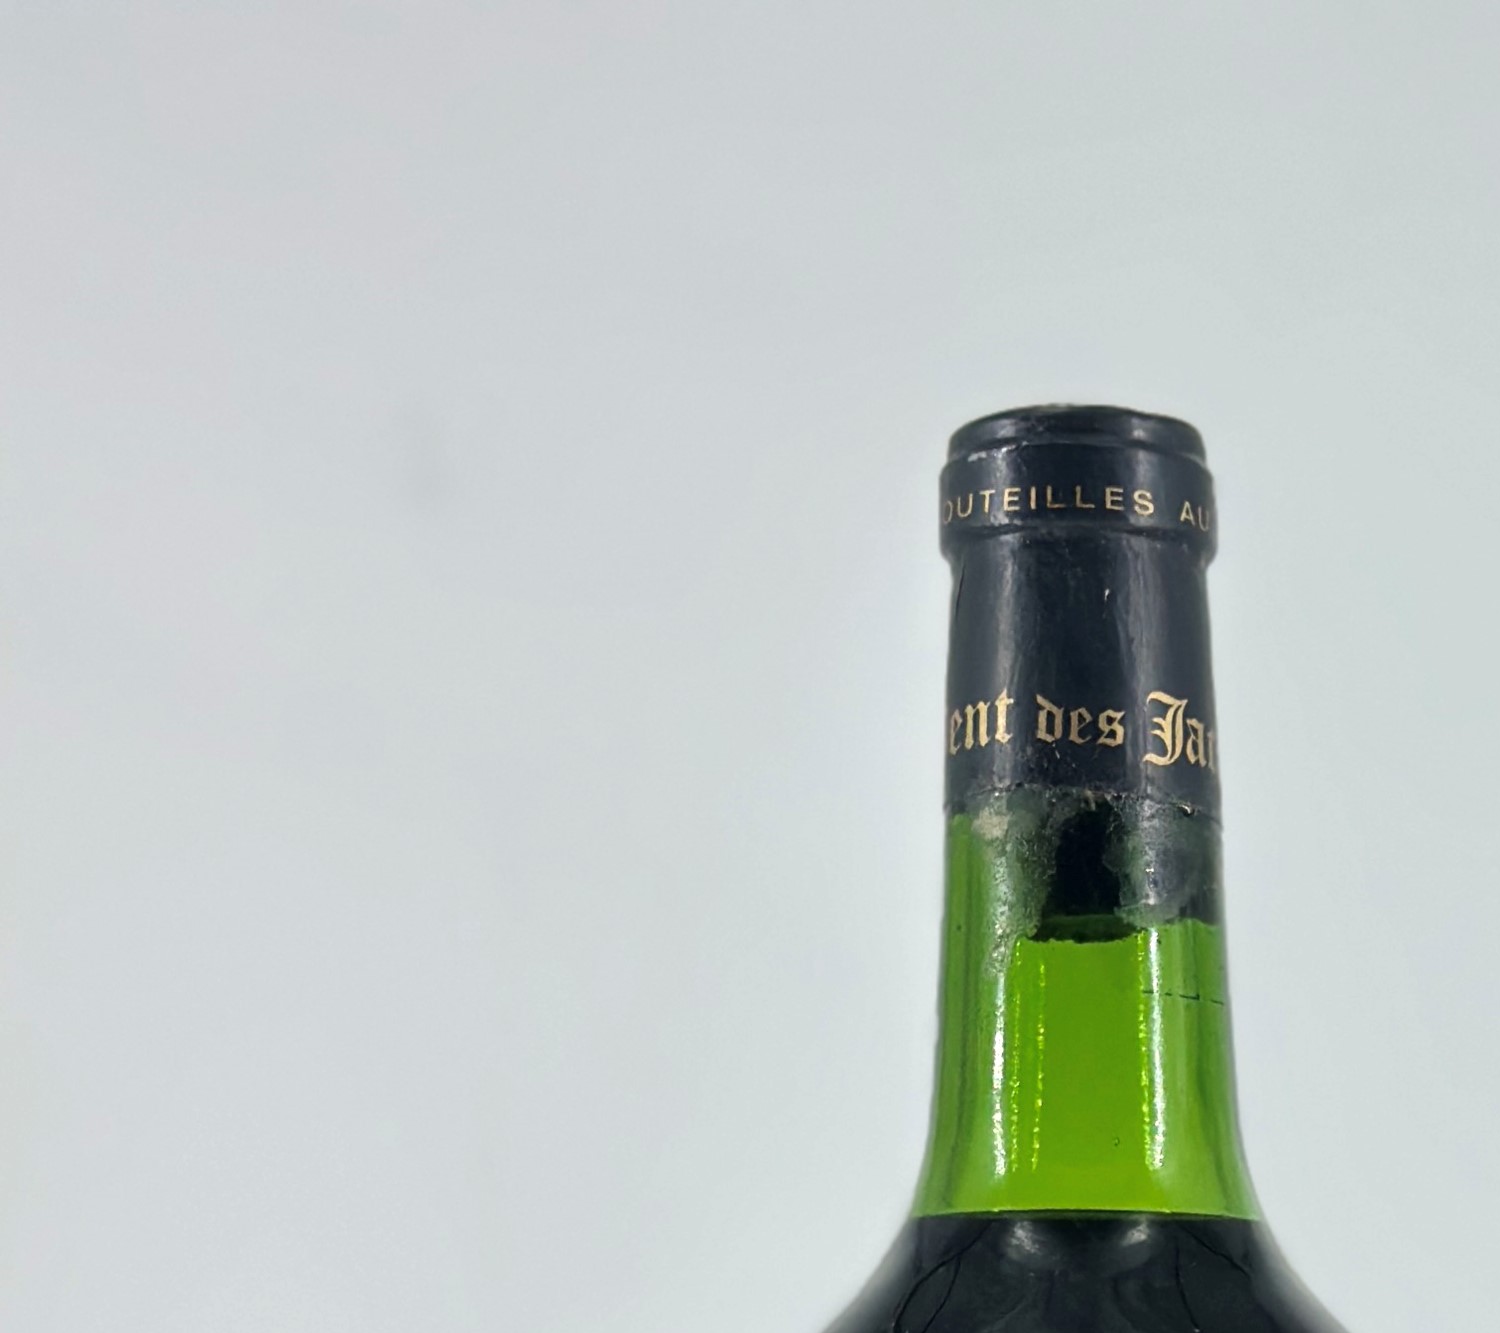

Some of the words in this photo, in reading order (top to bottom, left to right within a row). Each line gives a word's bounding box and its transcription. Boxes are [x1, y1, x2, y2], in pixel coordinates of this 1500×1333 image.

[1180, 501, 1210, 532] AU
[949, 688, 1015, 756] ent
[1035, 693, 1126, 748] des
